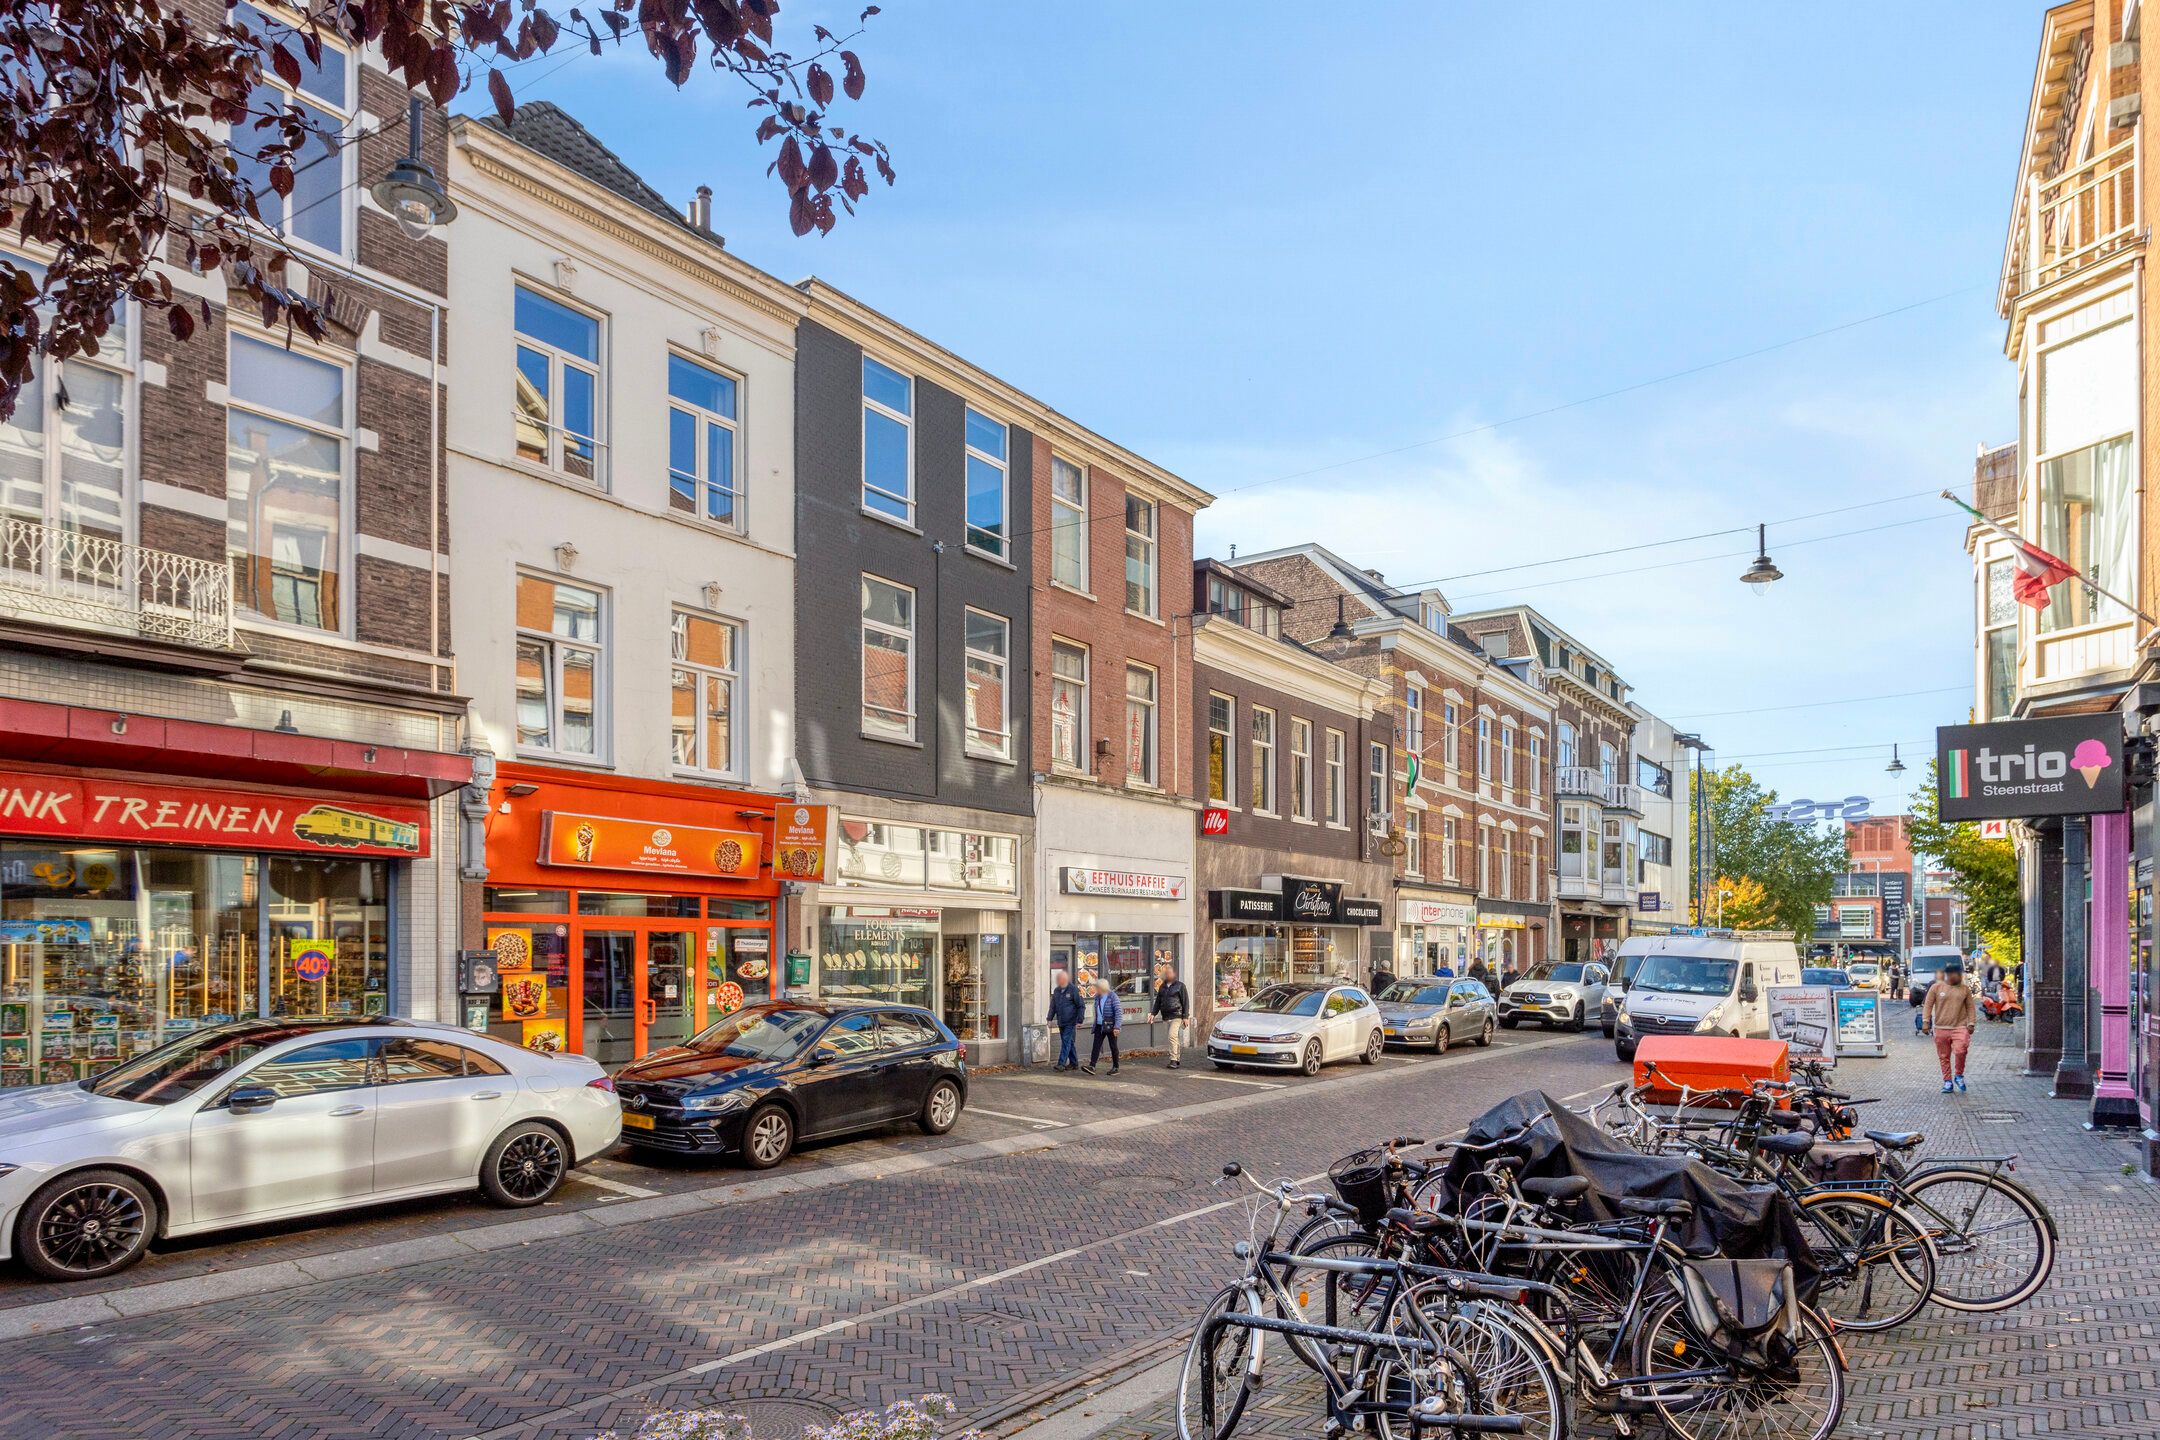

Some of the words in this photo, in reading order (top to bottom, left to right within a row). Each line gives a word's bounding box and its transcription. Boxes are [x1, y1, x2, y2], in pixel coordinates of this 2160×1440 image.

[1976, 744, 2066, 783] trio
[1983, 782, 2064, 796] Steenstraat
[93, 795, 283, 834] TREINEN
[1205, 812, 1226, 832] illy
[789, 826, 814, 834] Mevlana
[643, 845, 677, 856] Mevlana
[1092, 871, 1134, 887] EETHUIS
[1137, 875, 1166, 889] FAFFIE
[1088, 885, 1111, 893] CHINEES
[1111, 887, 1139, 895] SURINAAMS
[1240, 900, 1274, 912] PATISSERIE
[1346, 907, 1378, 917] CHOCOLATERIE
[1421, 903, 1464, 918] interphone
[865, 919, 893, 930] FOUR
[854, 930, 906, 941] ELEMENTS
[298, 957, 327, 974] 40%
